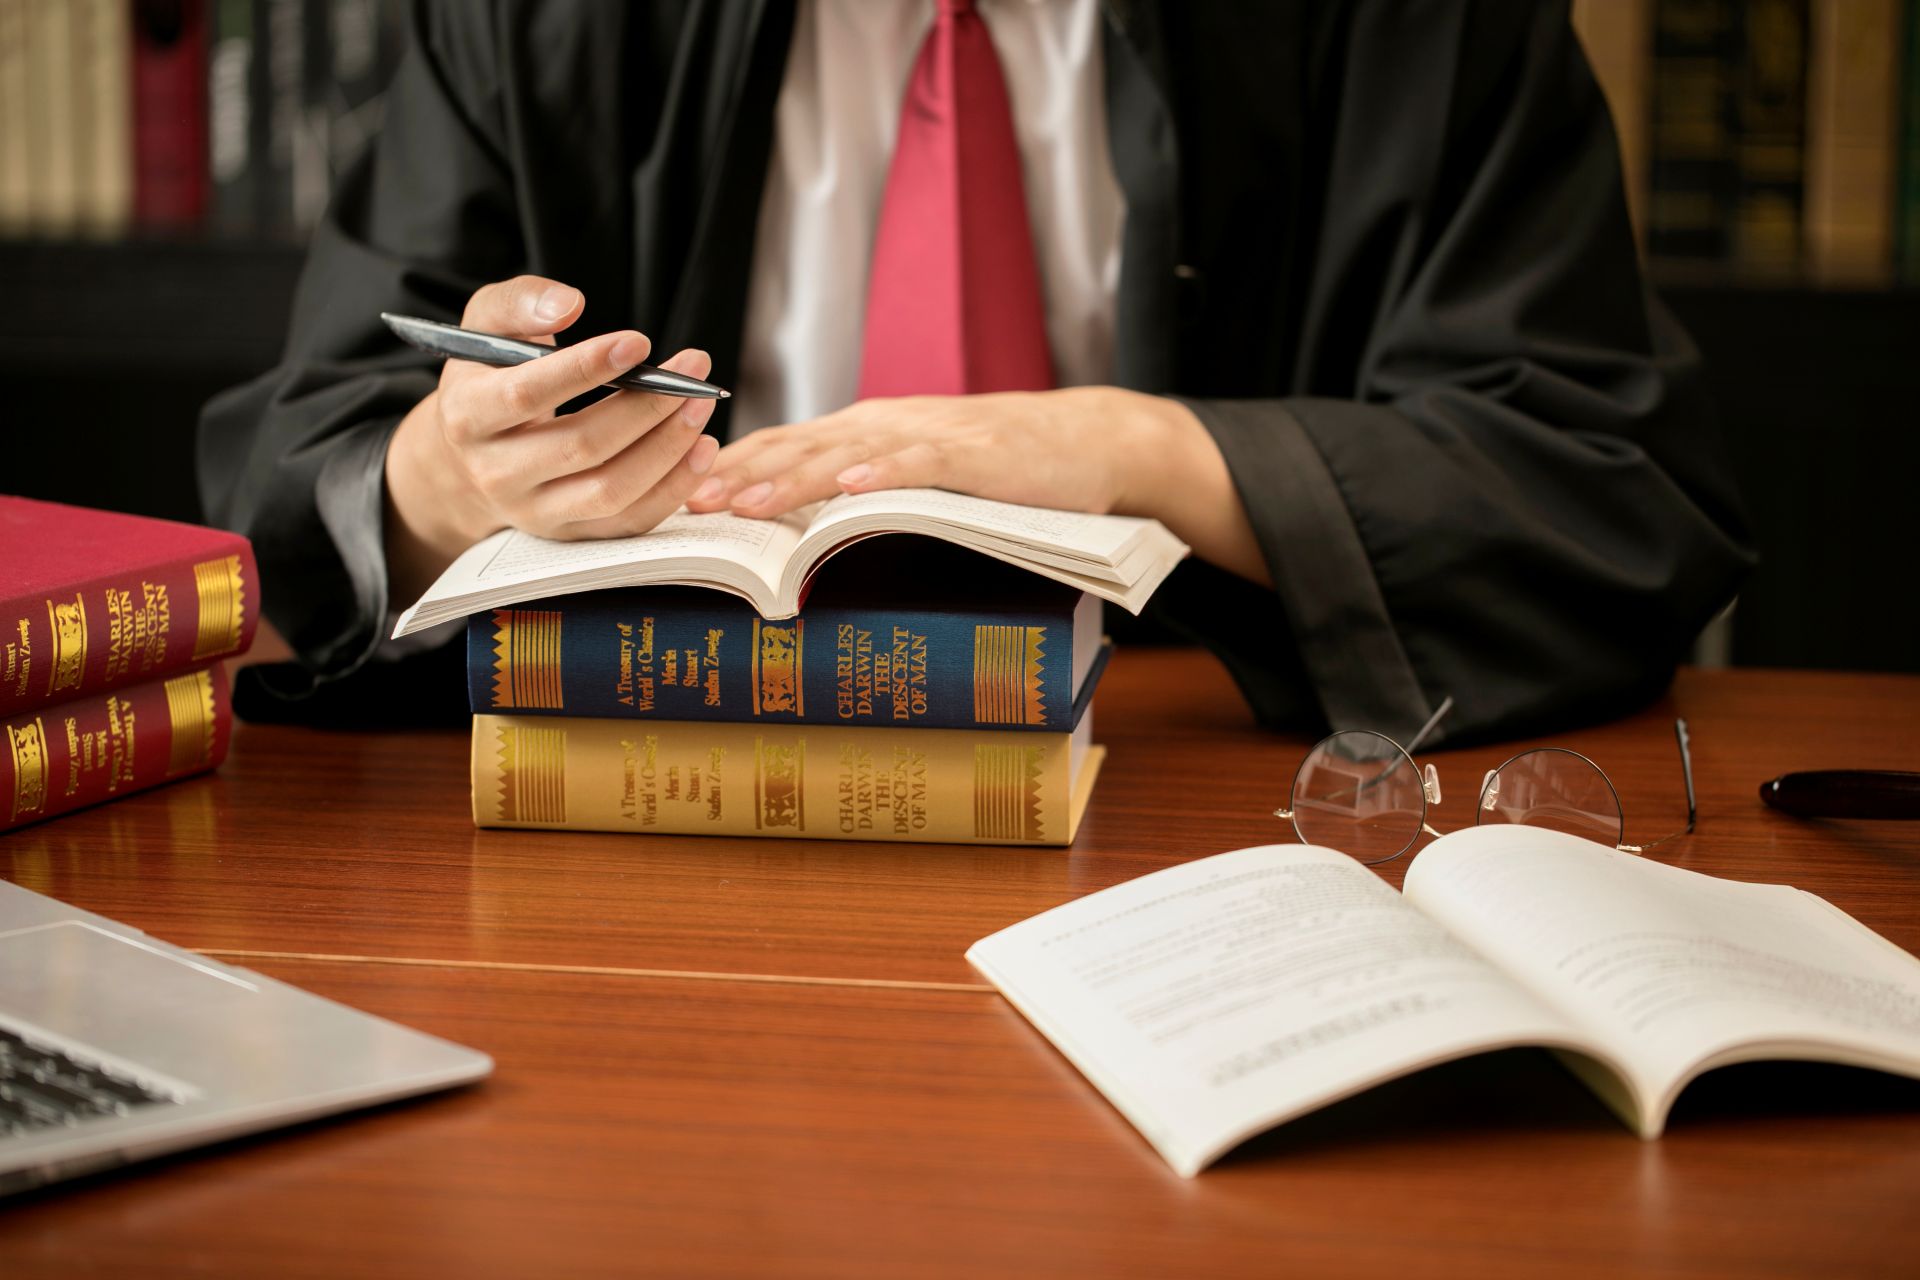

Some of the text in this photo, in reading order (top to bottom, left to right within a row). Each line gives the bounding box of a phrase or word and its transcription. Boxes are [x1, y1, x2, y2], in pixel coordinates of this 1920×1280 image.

[105, 588, 121, 682] CHARLES
[118, 591, 134, 674] DARWIN
[134, 608, 147, 653] THE
[141, 581, 158, 671] DESCENT
[154, 585, 170, 664] OF MAN
[617, 622, 636, 706] A Treasury of
[637, 617, 655, 664] Classics
[704, 629, 724, 667] Zweig
[121, 701, 131, 712] A
[683, 649, 698, 688] Stuart
[837, 624, 854, 719] CHARLES
[856, 629, 873, 716] DARWIN
[874, 652, 890, 697] THE
[893, 626, 909, 720] DESCENT
[911, 634, 928, 715] OF MAN
[621, 811, 636, 820] A
[839, 743, 855, 834] CHARLES
[858, 747, 873, 830] DARWIN
[876, 771, 890, 812] THE
[894, 746, 910, 834] DESCENT
[912, 751, 928, 830] OF MAN
